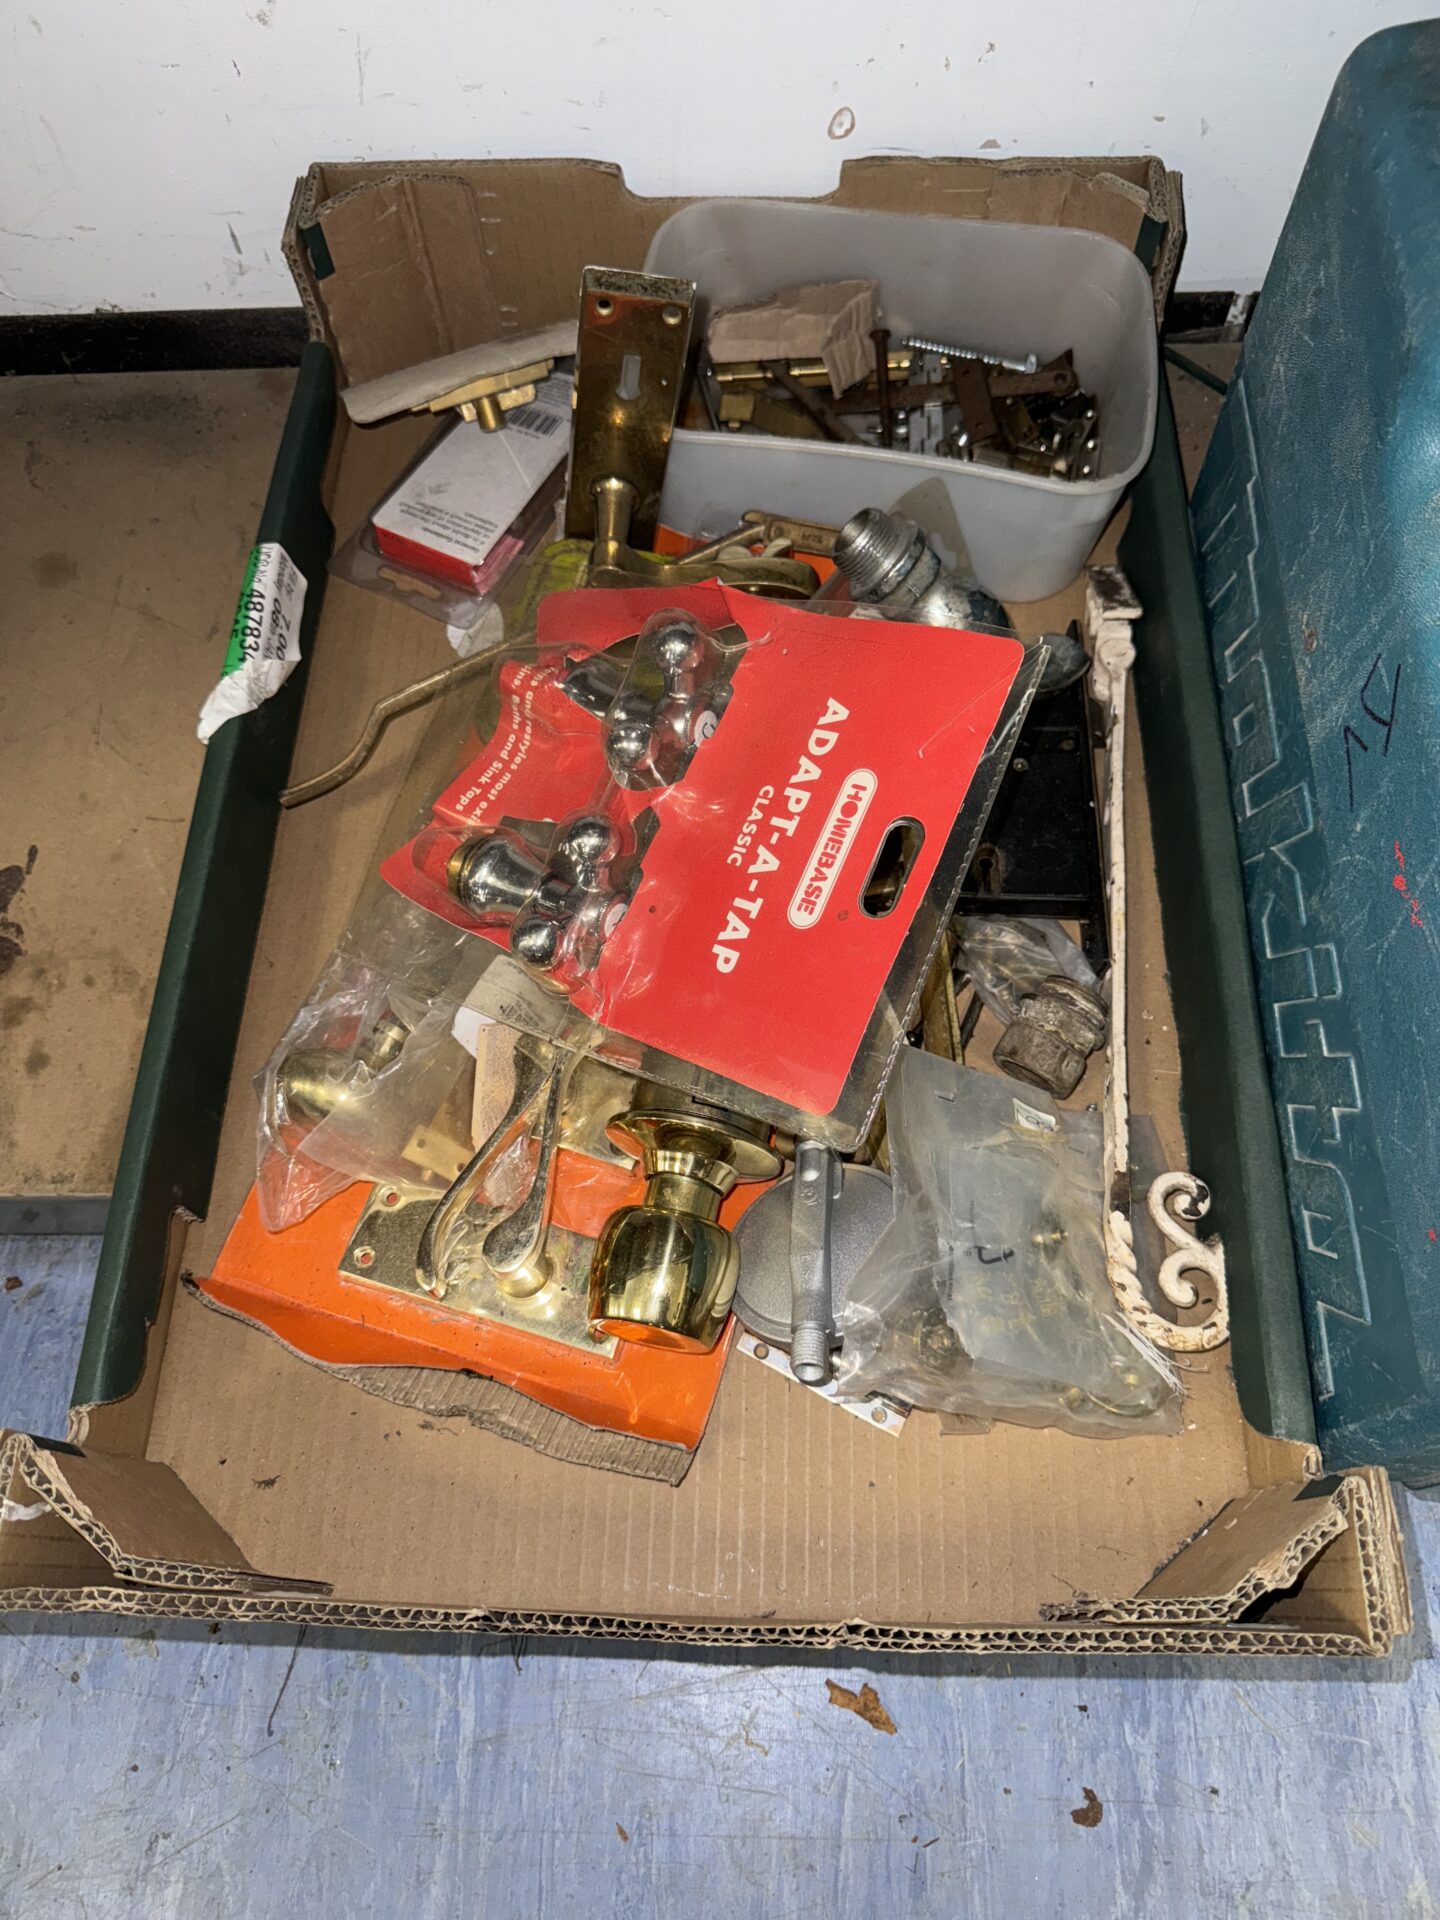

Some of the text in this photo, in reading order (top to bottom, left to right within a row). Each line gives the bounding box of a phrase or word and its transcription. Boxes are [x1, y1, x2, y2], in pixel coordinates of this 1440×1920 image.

[238, 588, 266, 663] 487834
[511, 694, 521, 730] Baths
[524, 691, 534, 719] and
[499, 733, 517, 761] and
[510, 719, 533, 771] restyles
[478, 760, 503, 785] Sink
[486, 772, 512, 801] most
[455, 786, 483, 812] Taps
[711, 696, 851, 974] ADAPT-A-TAP
[726, 784, 775, 867] CLASSIC
[797, 783, 868, 917] HOMEBASE
